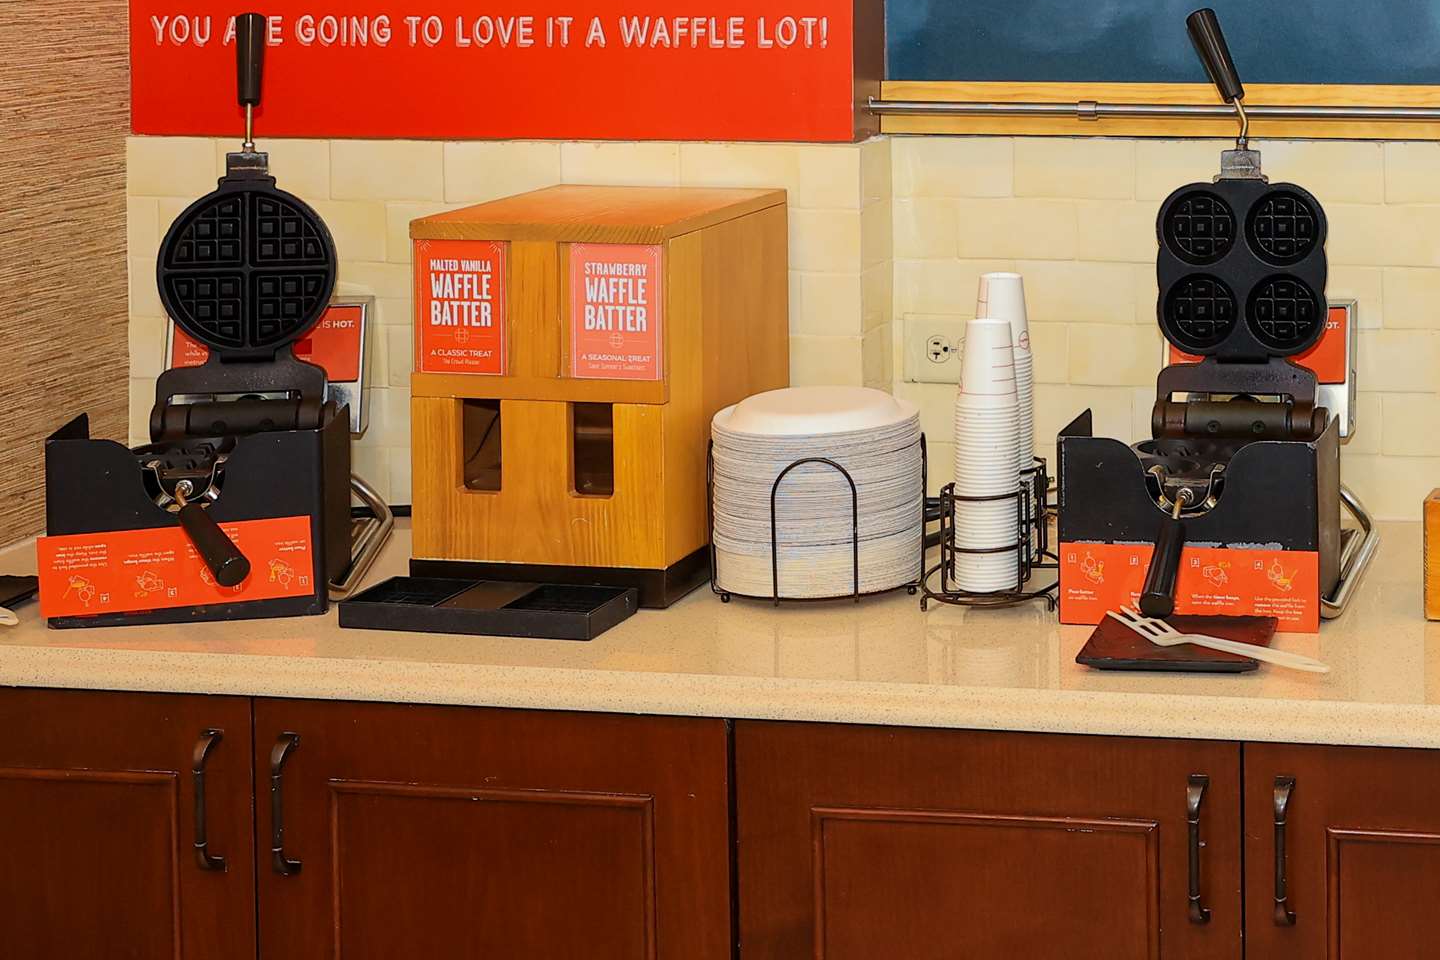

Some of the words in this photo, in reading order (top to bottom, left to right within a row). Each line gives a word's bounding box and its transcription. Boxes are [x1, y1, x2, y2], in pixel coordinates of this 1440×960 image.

[151, 15, 211, 45] YOU
[223, 15, 284, 47] AE
[298, 14, 391, 47] GOING
[406, 15, 443, 46] TO
[456, 15, 534, 47] LOVE
[546, 16, 573, 47] IT
[585, 16, 607, 48] A
[619, 16, 745, 49] WAFFLE
[757, 15, 829, 49] LOT!
[430, 259, 458, 271] MALTED
[460, 260, 491, 272] VANILLA
[584, 262, 647, 276] STRAWBERRY
[430, 272, 492, 299] WAFFLE
[584, 277, 647, 305] WAFFLE
[430, 300, 492, 327] BATTER
[584, 304, 647, 332] BATTER
[322, 320, 331, 329] IS
[332, 320, 355, 329] HOT.
[437, 349, 468, 357] CLASSIC
[588, 354, 626, 362] SEASONAL
